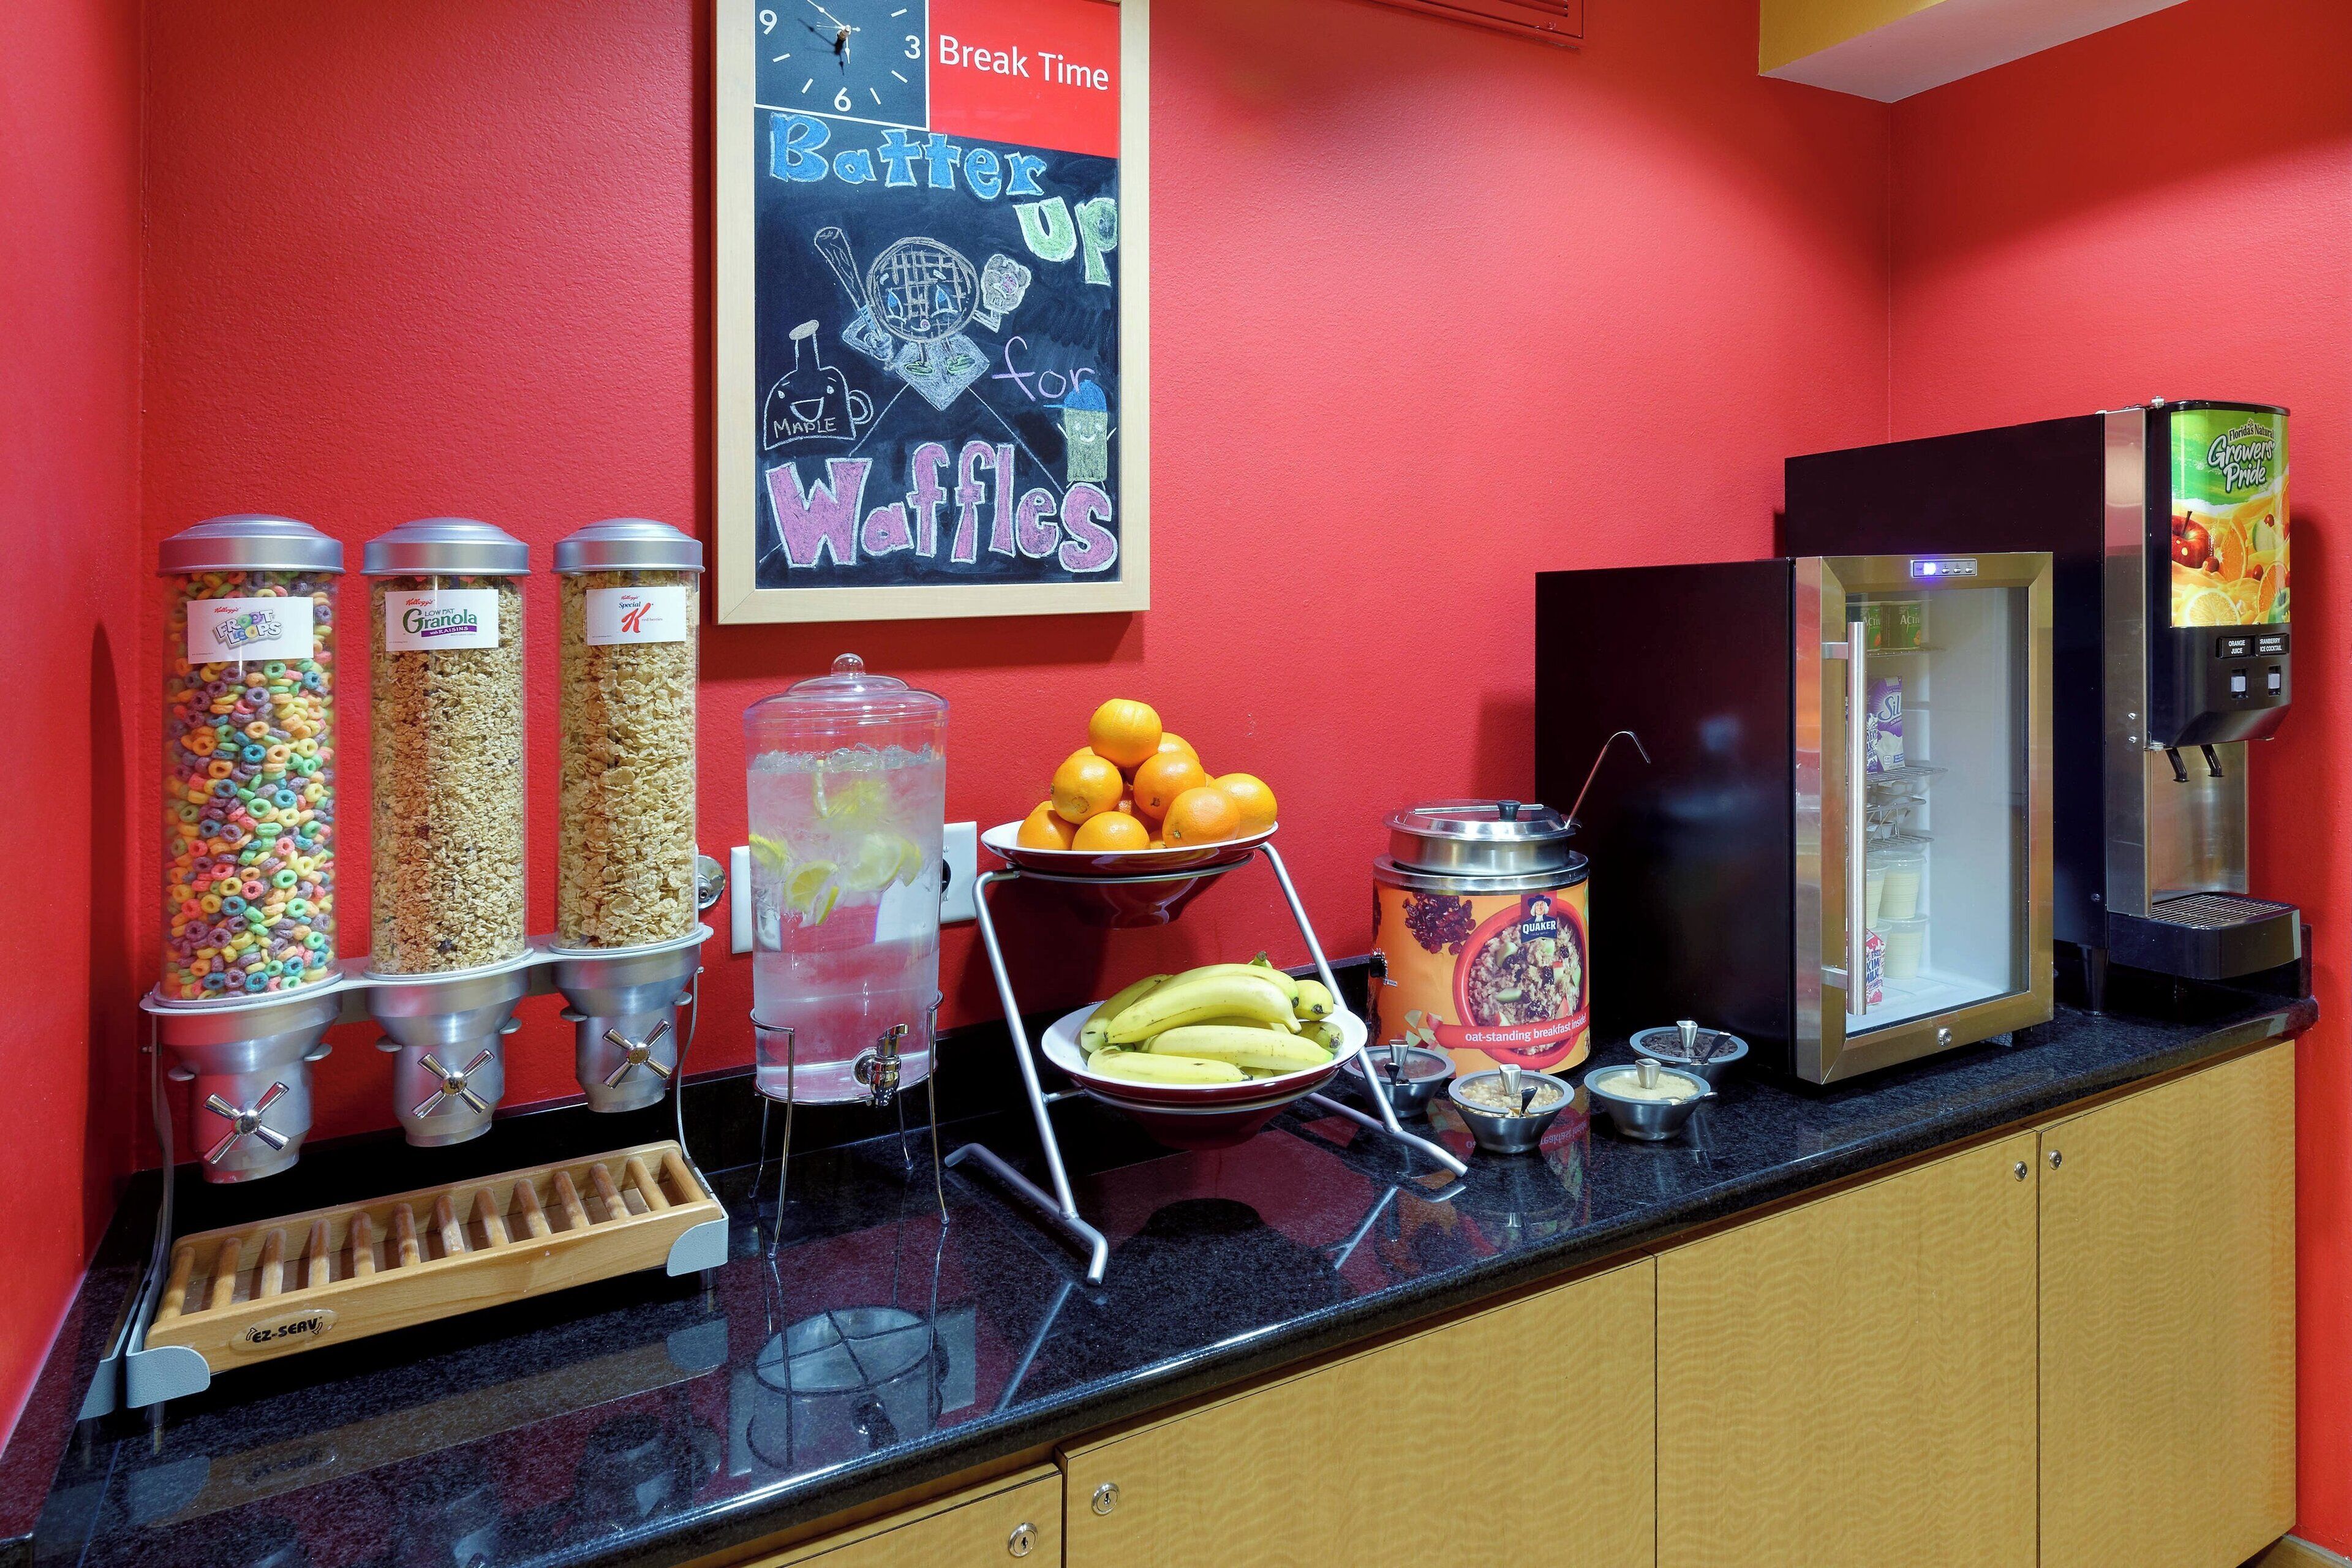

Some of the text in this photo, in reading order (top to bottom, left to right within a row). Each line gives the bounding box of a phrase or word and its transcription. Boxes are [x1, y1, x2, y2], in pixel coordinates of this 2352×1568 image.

[760, 10, 777, 35] 9
[904, 35, 921, 59] 3
[938, 34, 1109, 90] Break Time
[834, 87, 851, 111] 6
[770, 111, 1047, 200] Batter
[992, 336, 1095, 401] for
[2255, 424, 2274, 439] Natural
[2223, 460, 2266, 492] Pride
[765, 441, 1118, 573] Waffles
[216, 610, 273, 638] FROOT
[403, 608, 477, 633] Granola
[621, 603, 651, 633] K
[227, 622, 282, 644] LOOPS
[1523, 921, 1556, 935] QUAKER
[1866, 958, 1880, 972] KIM
[1465, 1013, 1586, 1042] oat-standing breakfast inside!
[252, 1317, 318, 1343] EZ-SERV
